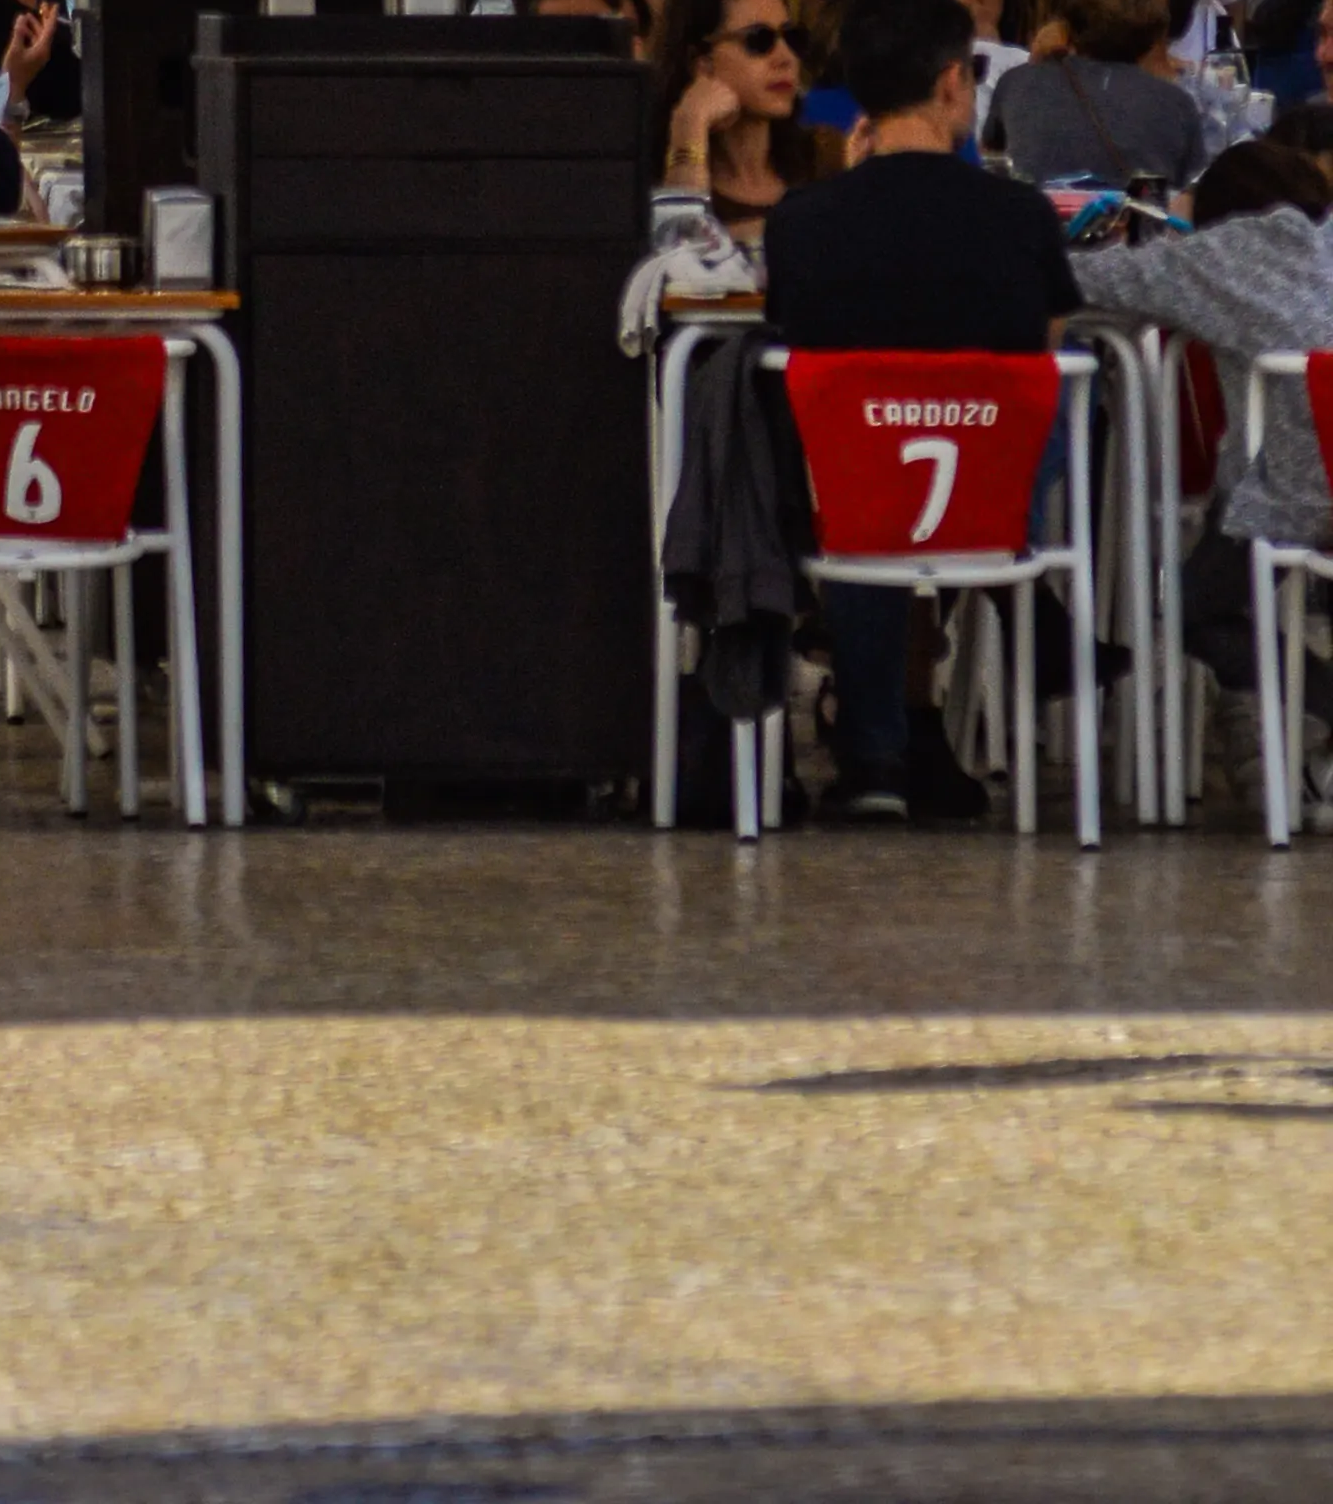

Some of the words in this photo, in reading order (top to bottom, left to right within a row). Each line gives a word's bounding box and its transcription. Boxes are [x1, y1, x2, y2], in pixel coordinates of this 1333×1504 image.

[863, 400, 999, 427] CARDOZO
[3, 420, 62, 524] 6
[901, 438, 959, 544] 7
